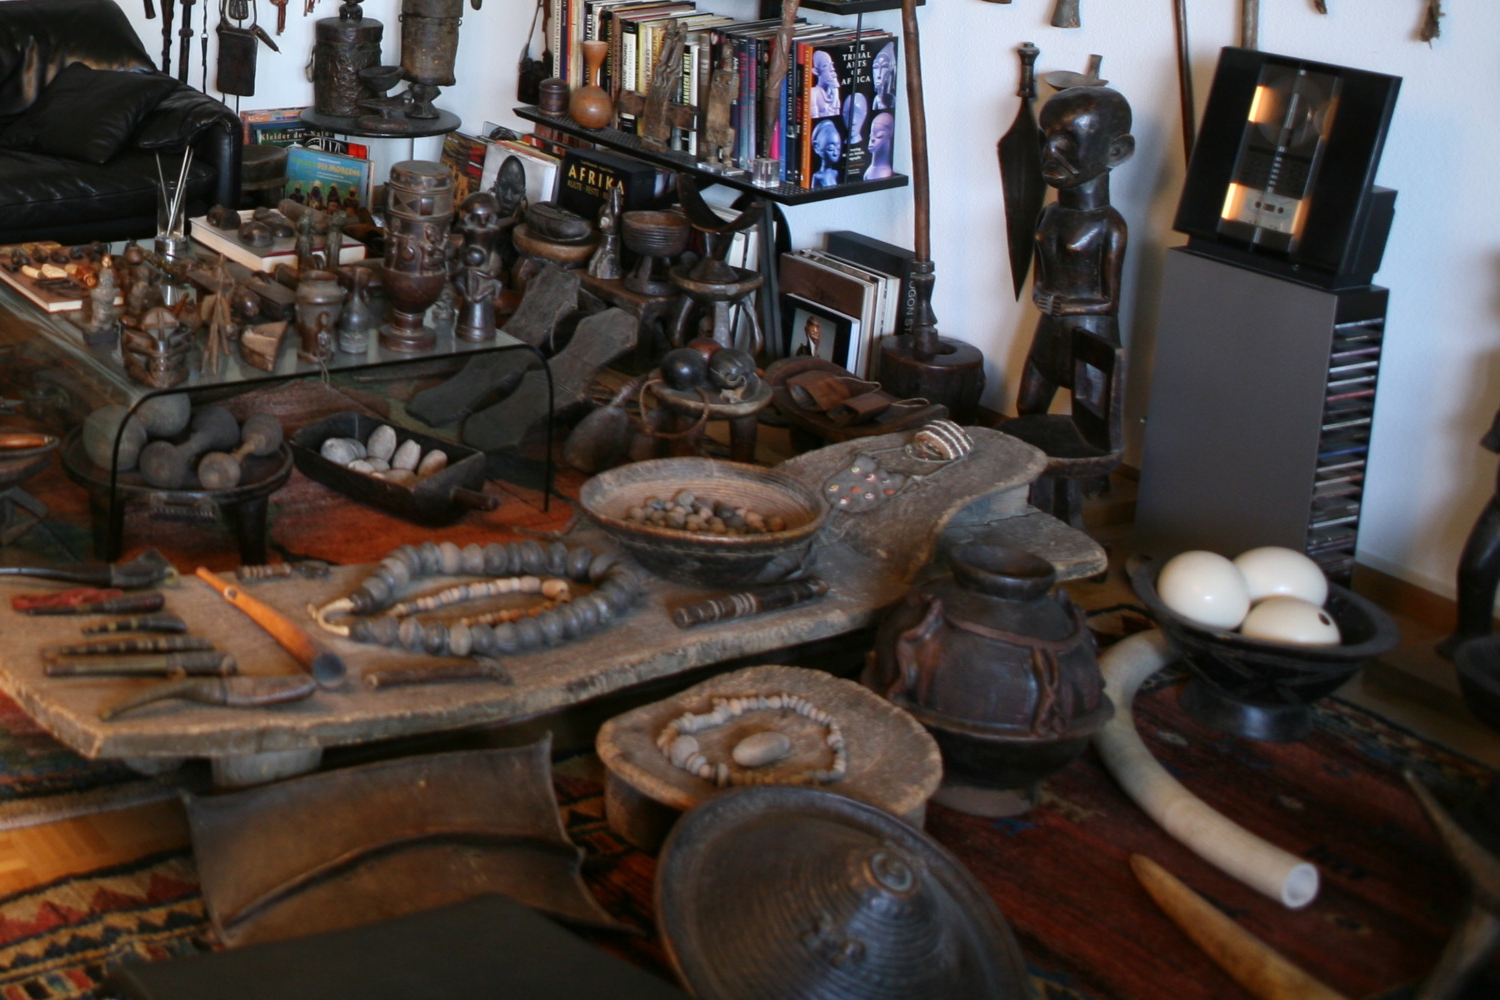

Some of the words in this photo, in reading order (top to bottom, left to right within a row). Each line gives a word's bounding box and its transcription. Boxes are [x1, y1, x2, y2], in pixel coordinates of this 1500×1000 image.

[849, 44, 865, 53] TE
[841, 76, 871, 86] AFICA
[261, 132, 290, 141] Kleider
[568, 164, 625, 195] AFRIKA
